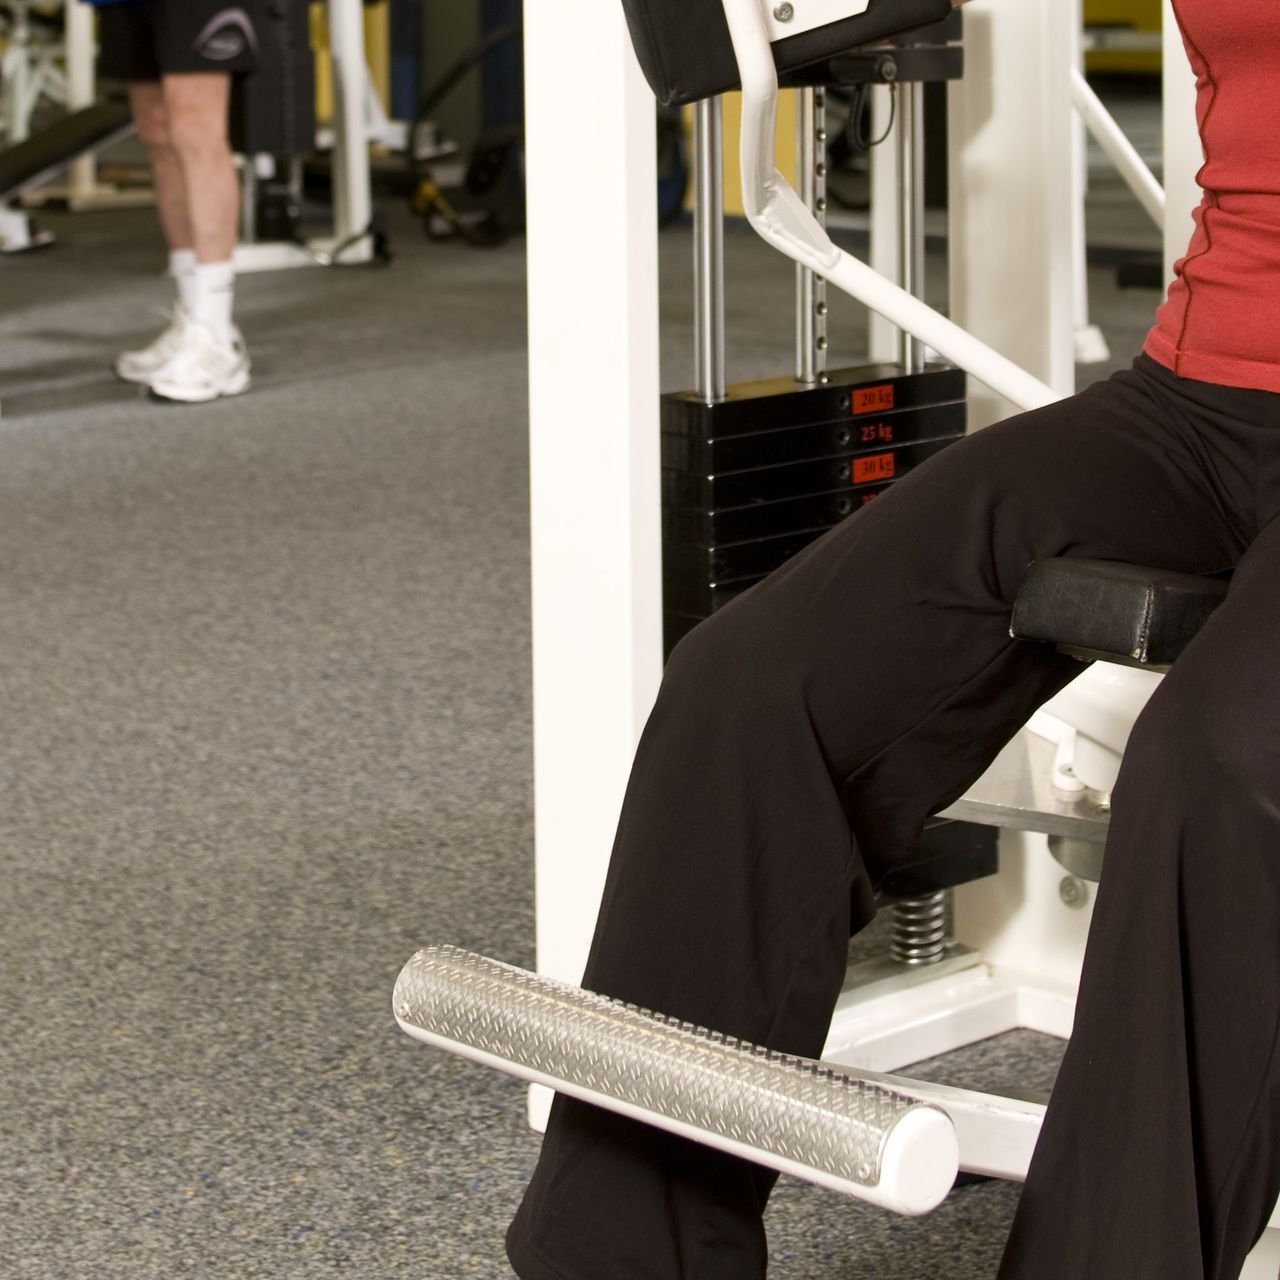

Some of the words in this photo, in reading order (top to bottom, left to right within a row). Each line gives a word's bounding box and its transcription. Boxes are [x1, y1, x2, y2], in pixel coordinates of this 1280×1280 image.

[861, 392, 876, 407] 20
[879, 388, 893, 407] kg
[861, 425, 876, 441] 25
[878, 423, 893, 441] kg
[861, 460, 876, 476] 30
[879, 457, 893, 476] kg
